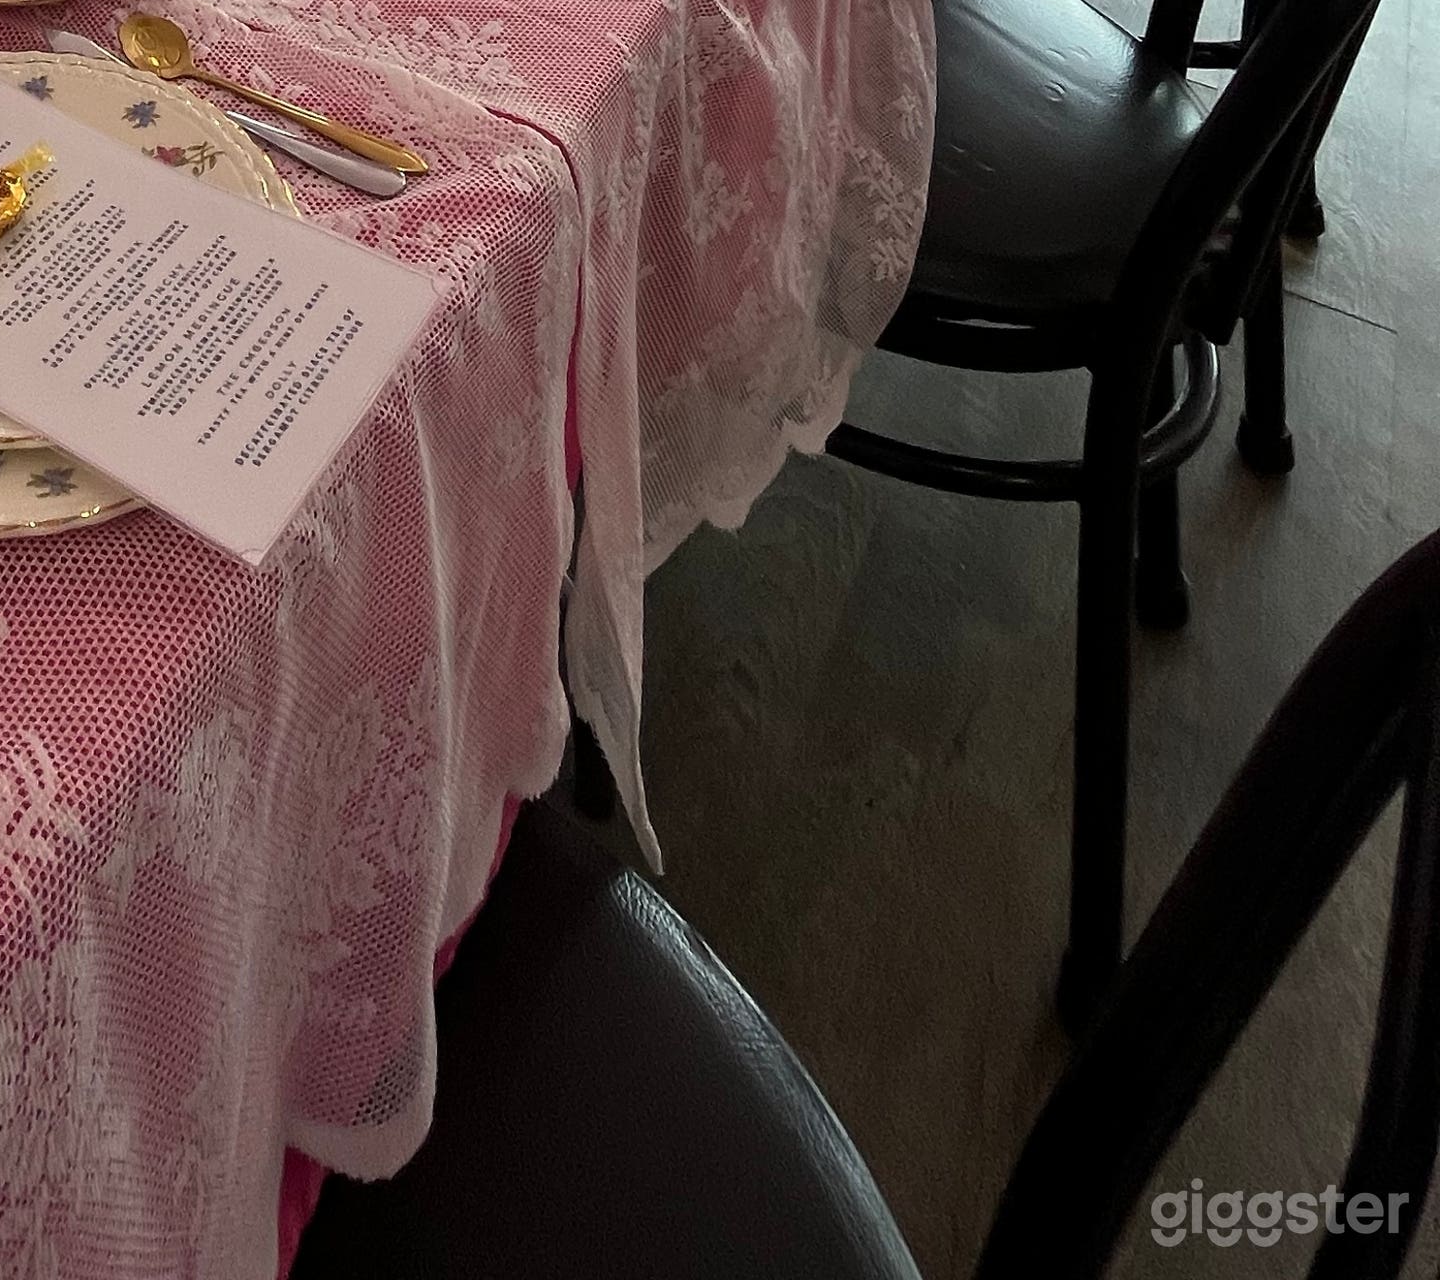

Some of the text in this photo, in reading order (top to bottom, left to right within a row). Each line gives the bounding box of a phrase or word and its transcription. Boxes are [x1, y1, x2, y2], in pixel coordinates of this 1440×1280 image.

[140, 277, 240, 387] LEMON MERINGUE
[215, 372, 239, 395] THE
[264, 360, 296, 399] DOLLY
